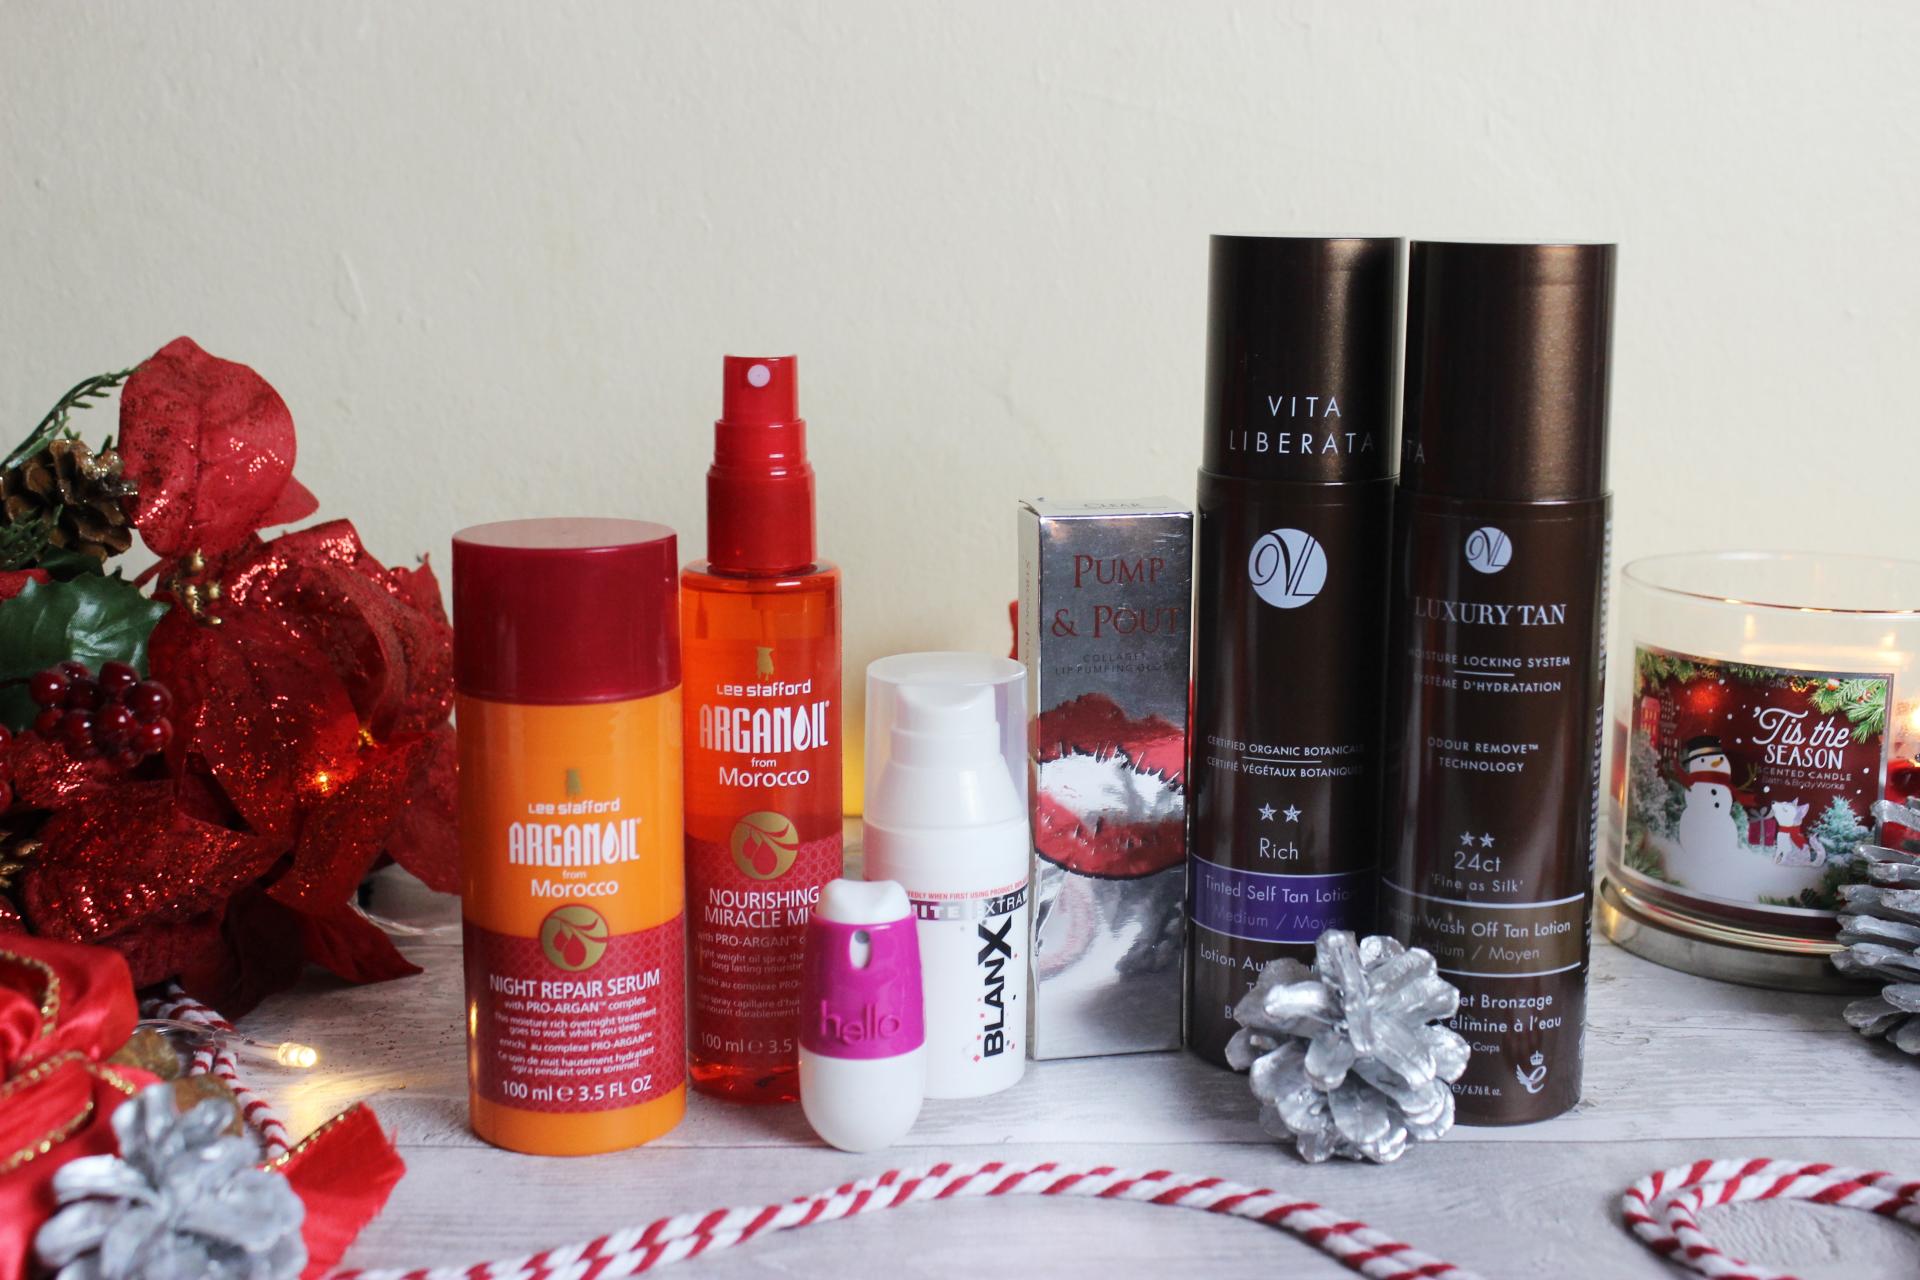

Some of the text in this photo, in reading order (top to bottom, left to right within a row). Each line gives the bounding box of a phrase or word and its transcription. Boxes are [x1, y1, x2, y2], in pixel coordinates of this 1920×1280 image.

[1268, 395, 1342, 418] VITA
[1229, 430, 1375, 455] LIBERATA
[1073, 554, 1166, 588] PUMP
[1414, 597, 1567, 626] LUXURY TAN
[1052, 605, 1184, 639] & POUT
[1463, 656, 1523, 668] LOCKING
[1527, 656, 1571, 668] SYSTEM
[716, 678, 812, 698] Lee stafford
[1463, 680, 1562, 693] D'HYDRATATION
[1809, 716, 1850, 749] the
[1207, 735, 1246, 751] CERTIFIED
[1249, 744, 1300, 756] ORGANIC
[1427, 736, 1469, 752] ODOUR
[751, 756, 777, 768] from
[1438, 756, 1526, 773] TECHNOLOGY
[1764, 743, 1844, 770] SEASON
[719, 766, 810, 788] Morocco
[1242, 763, 1297, 778] VÉGÉTAUX
[1807, 770, 1853, 782] CANDLE
[557, 797, 621, 815] stafford
[1259, 837, 1299, 861] Rich
[1453, 850, 1502, 873] 24ct
[562, 869, 587, 880] from
[530, 879, 619, 898] Morocco
[950, 891, 968, 901] FIRST
[1205, 875, 1351, 903] Tinted Self Tan Lotio
[1469, 882, 1485, 892] as
[709, 885, 820, 910] NOURISHING
[705, 905, 809, 929] MIRACLE MI
[1276, 913, 1288, 930] /
[1425, 915, 1465, 934] Wash
[1471, 922, 1499, 937] Off
[1504, 925, 1529, 938] Tan
[1535, 920, 1571, 937] Lotion
[1200, 943, 1236, 968] Lotion
[1472, 945, 1483, 960] /
[1488, 945, 1541, 964] Moyen
[489, 968, 661, 1000] NIGHT REPAIR SERUM
[978, 915, 1012, 1058] BLANX
[504, 1000, 525, 1012] with
[608, 996, 647, 1013] complex
[1481, 993, 1554, 1012] Bronzage
[510, 1016, 548, 1029] moisture
[550, 1020, 569, 1030] rich
[569, 1016, 616, 1031] overnight
[617, 1007, 657, 1025] treatment
[819, 1000, 900, 1045] hello
[1513, 1018, 1524, 1033] à
[509, 1026, 529, 1037] goes
[530, 1027, 541, 1037] to
[542, 1029, 567, 1039] work
[568, 1027, 598, 1039] whilst
[600, 1026, 617, 1039] you
[530, 1042, 542, 1052] au
[543, 1042, 590, 1055] complexe
[725, 1037, 744, 1053] ml
[768, 1038, 793, 1054] 3.5
[1472, 1041, 1501, 1056] Corps
[526, 1056, 539, 1066] de
[540, 1057, 560, 1067] nuit
[561, 1054, 614, 1068] hautement
[615, 1046, 655, 1064] hydratant
[534, 1065, 574, 1078] pendant
[575, 1065, 601, 1077] votre
[502, 1080, 528, 1099] 100
[532, 1085, 553, 1101] ml
[578, 1084, 605, 1101] 3.5
[610, 1082, 627, 1098] FL
[631, 1074, 652, 1094] OZ
